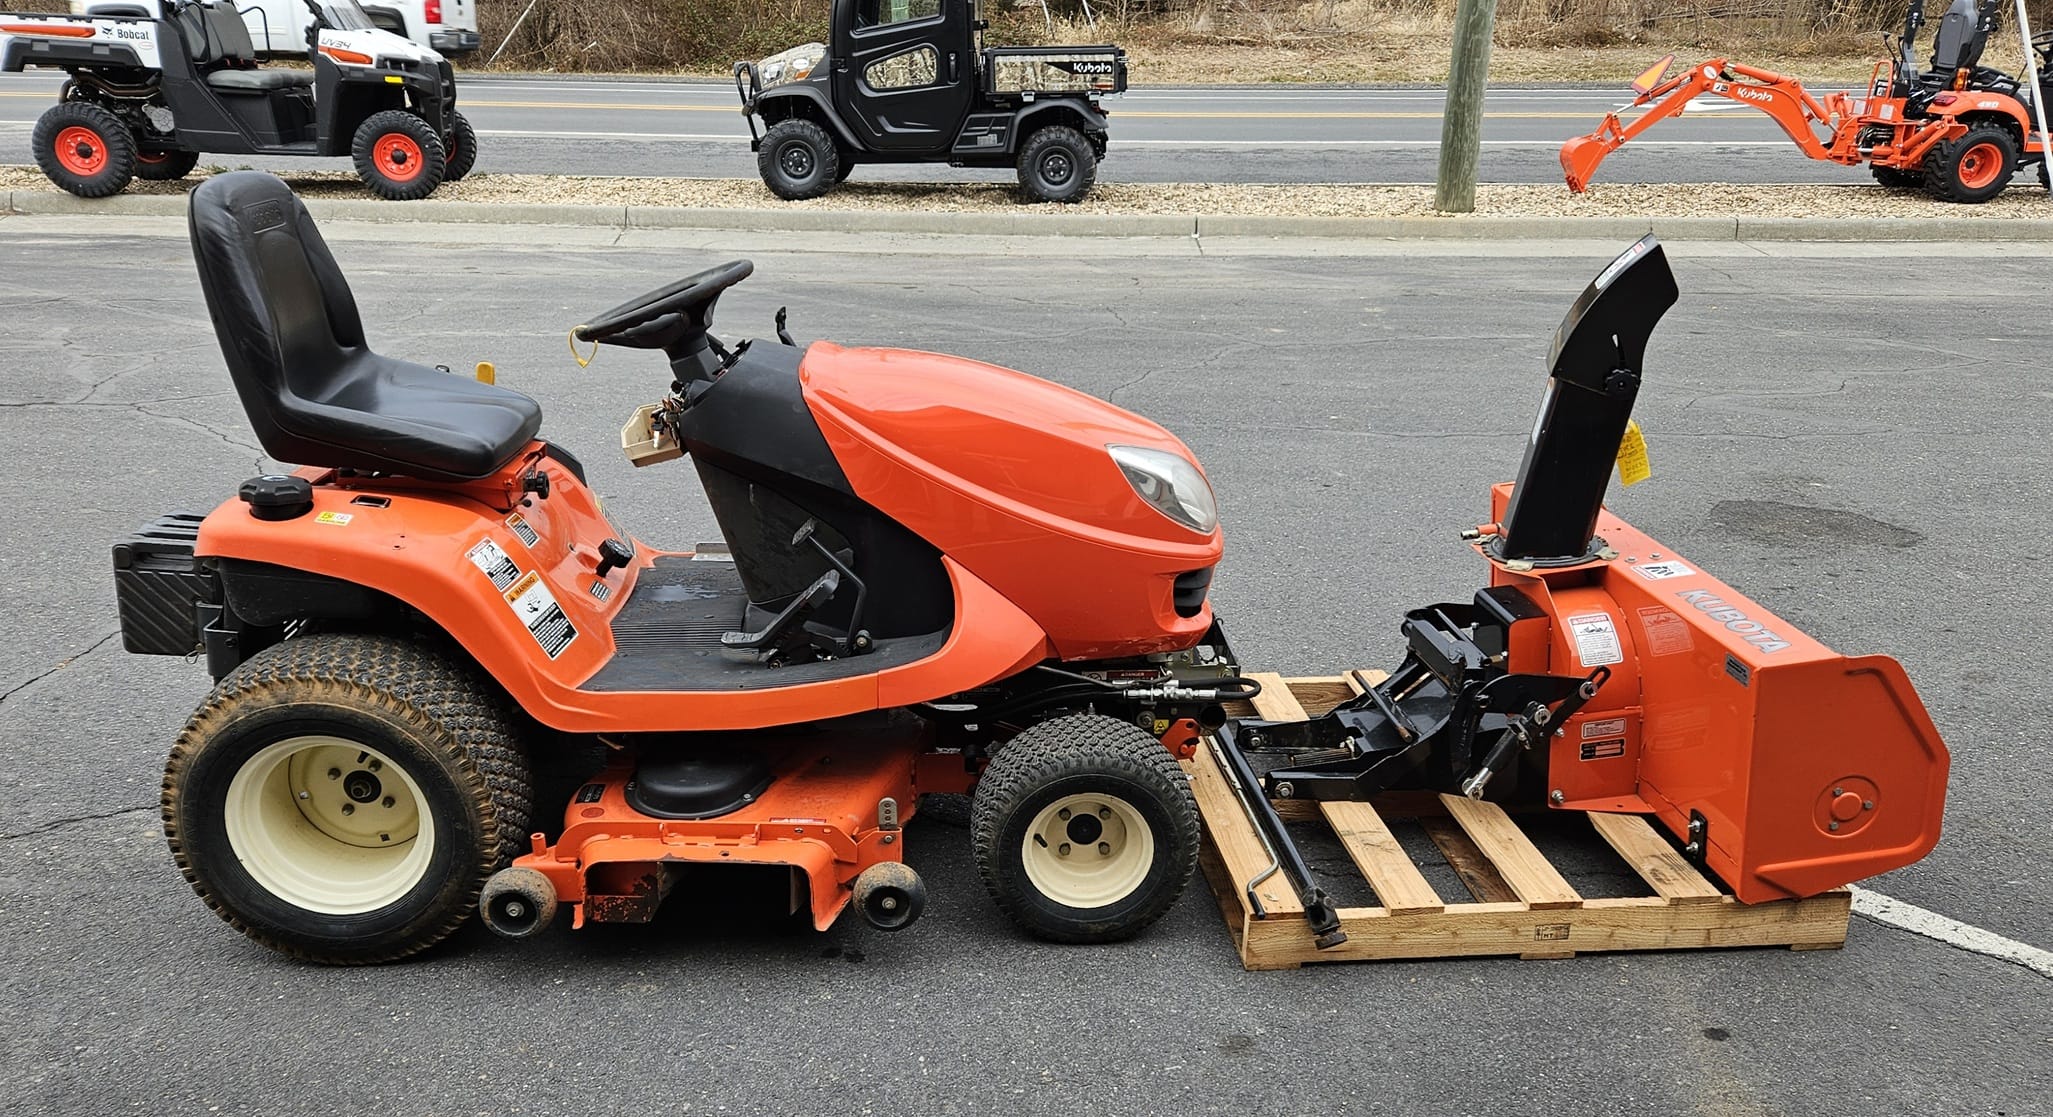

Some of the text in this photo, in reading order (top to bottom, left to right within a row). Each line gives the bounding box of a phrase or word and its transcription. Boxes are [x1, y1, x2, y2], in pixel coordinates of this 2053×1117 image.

[117, 29, 149, 40] Bobcat
[321, 38, 351, 49] UV34
[1073, 62, 1112, 73] Kubota
[1737, 87, 1773, 102] Kubota
[1675, 589, 1792, 654] KUBOTA
